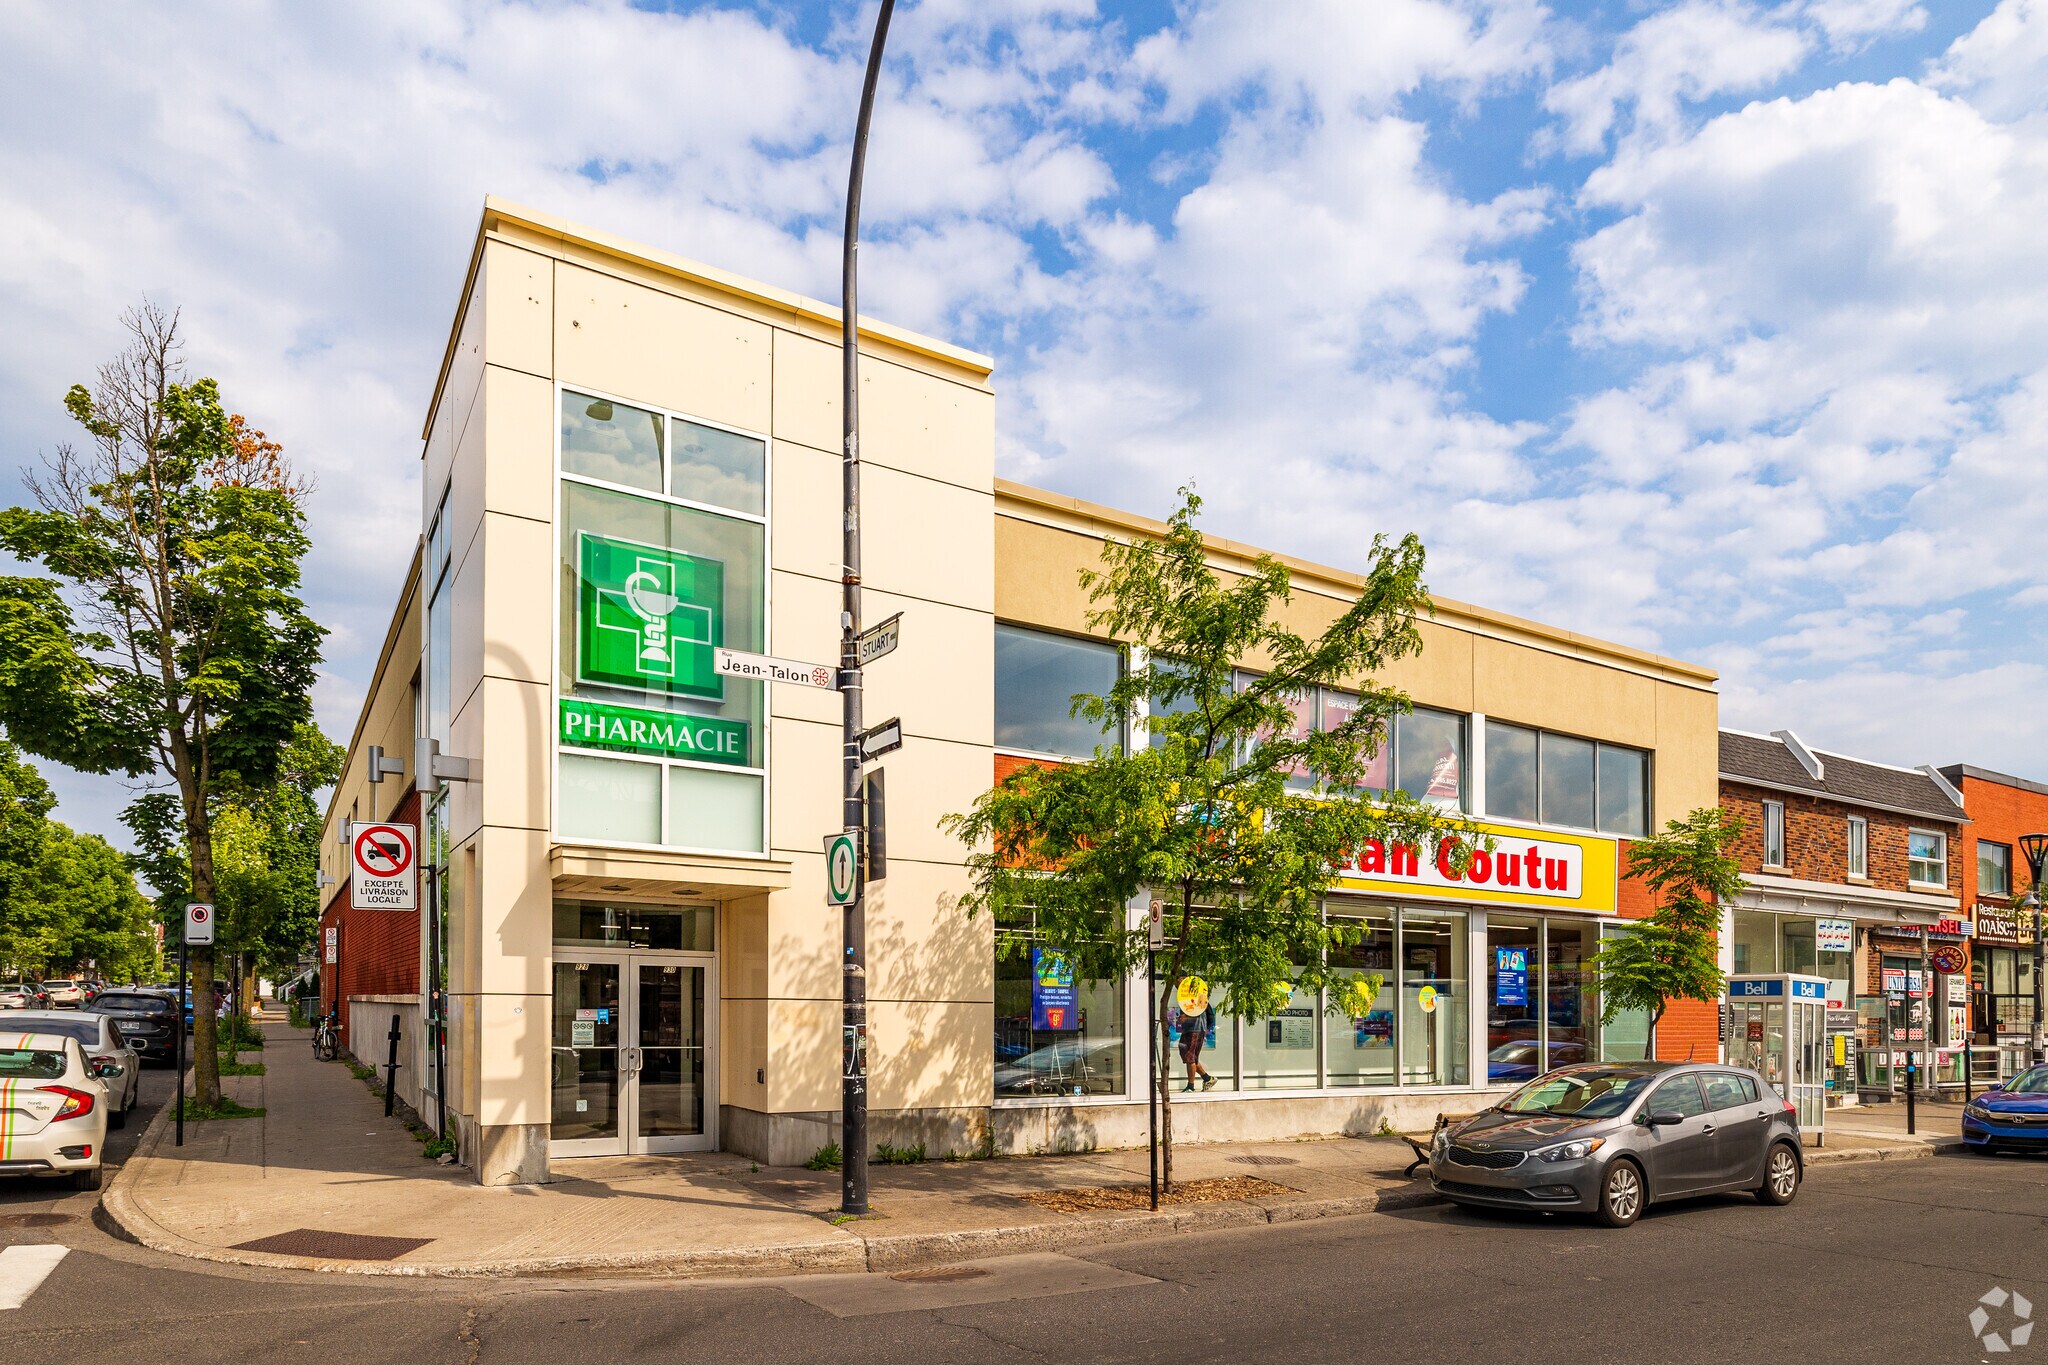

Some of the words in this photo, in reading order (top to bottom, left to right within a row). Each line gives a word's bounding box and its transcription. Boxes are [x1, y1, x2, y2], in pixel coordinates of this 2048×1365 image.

[862, 632, 890, 657] STUART
[721, 650, 733, 658] Rue
[721, 658, 809, 682] Jean-Talon
[565, 711, 739, 754] PHARMACIE
[1437, 835, 1568, 891] Coutu
[364, 880, 404, 888] EXCEPTÉ
[360, 888, 409, 896] LIVRAISON
[367, 896, 401, 904] LOCALE
[1745, 981, 1768, 995] Bell
[1801, 983, 1816, 997] Bell
